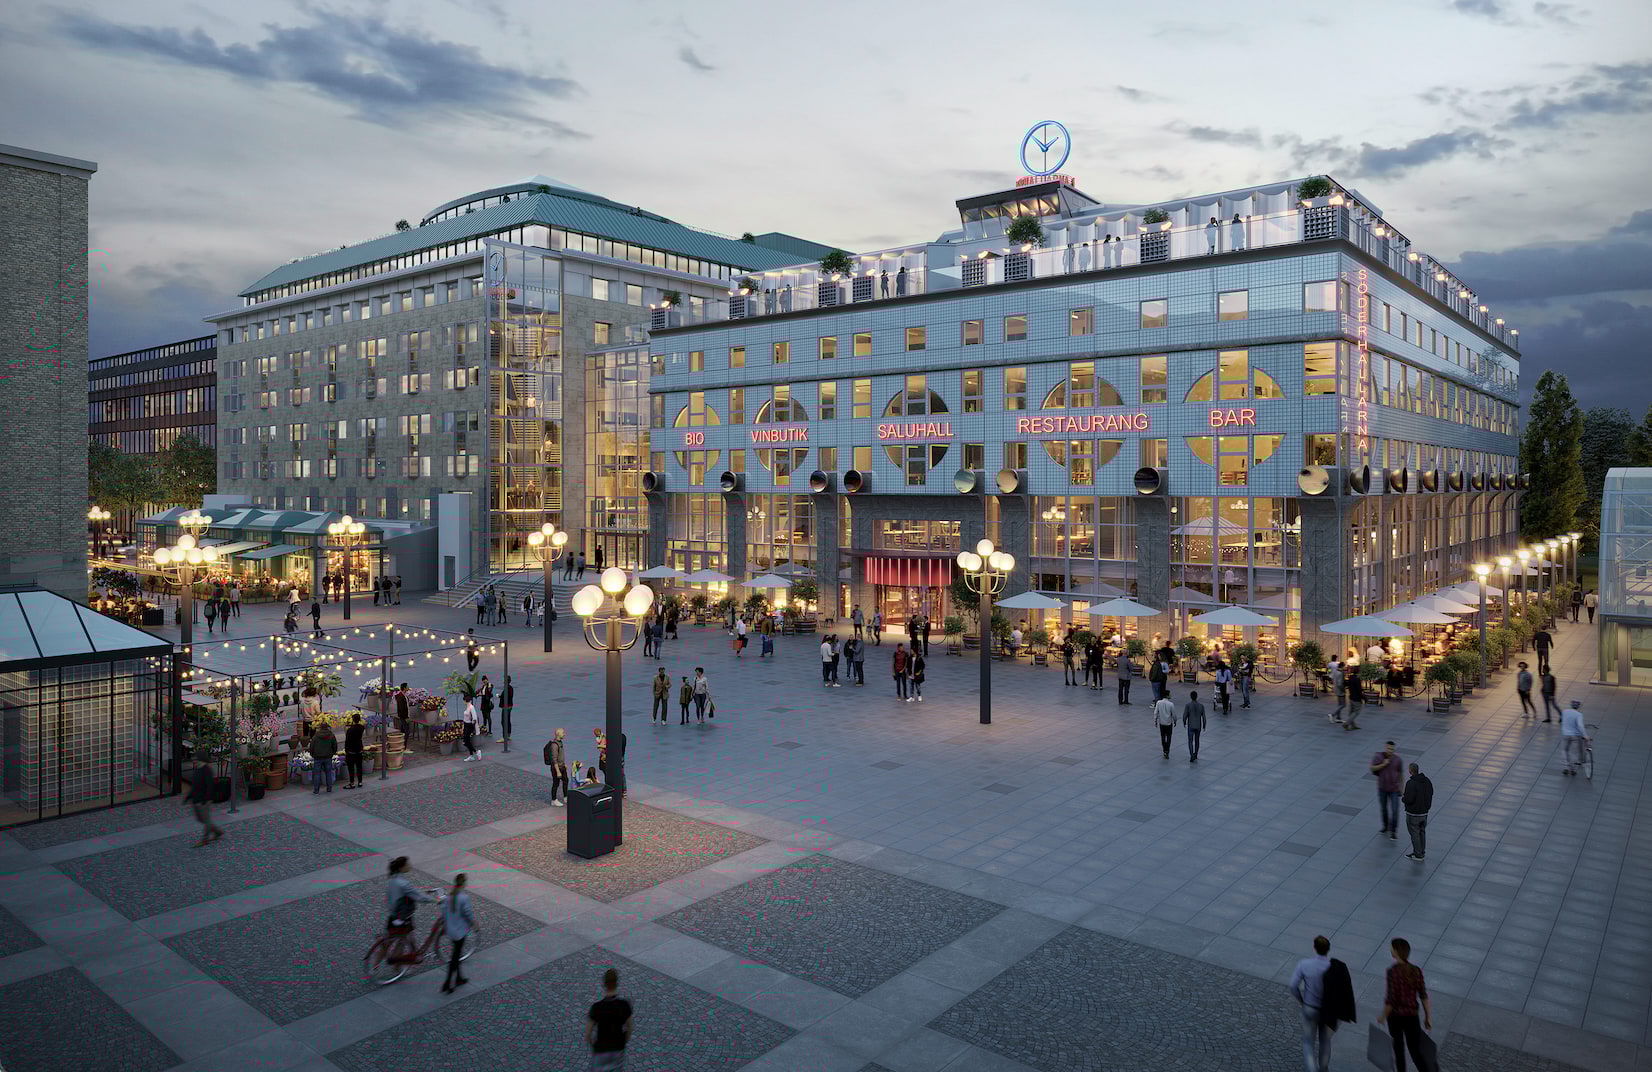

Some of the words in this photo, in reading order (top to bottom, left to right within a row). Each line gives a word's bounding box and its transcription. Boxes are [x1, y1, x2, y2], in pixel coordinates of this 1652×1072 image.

[1018, 413, 1149, 434] RESTAURANG
[1210, 408, 1256, 427] BAR
[685, 432, 705, 446] BIO
[751, 428, 809, 443] VINBUTIK
[878, 422, 955, 439] SALUHALL
